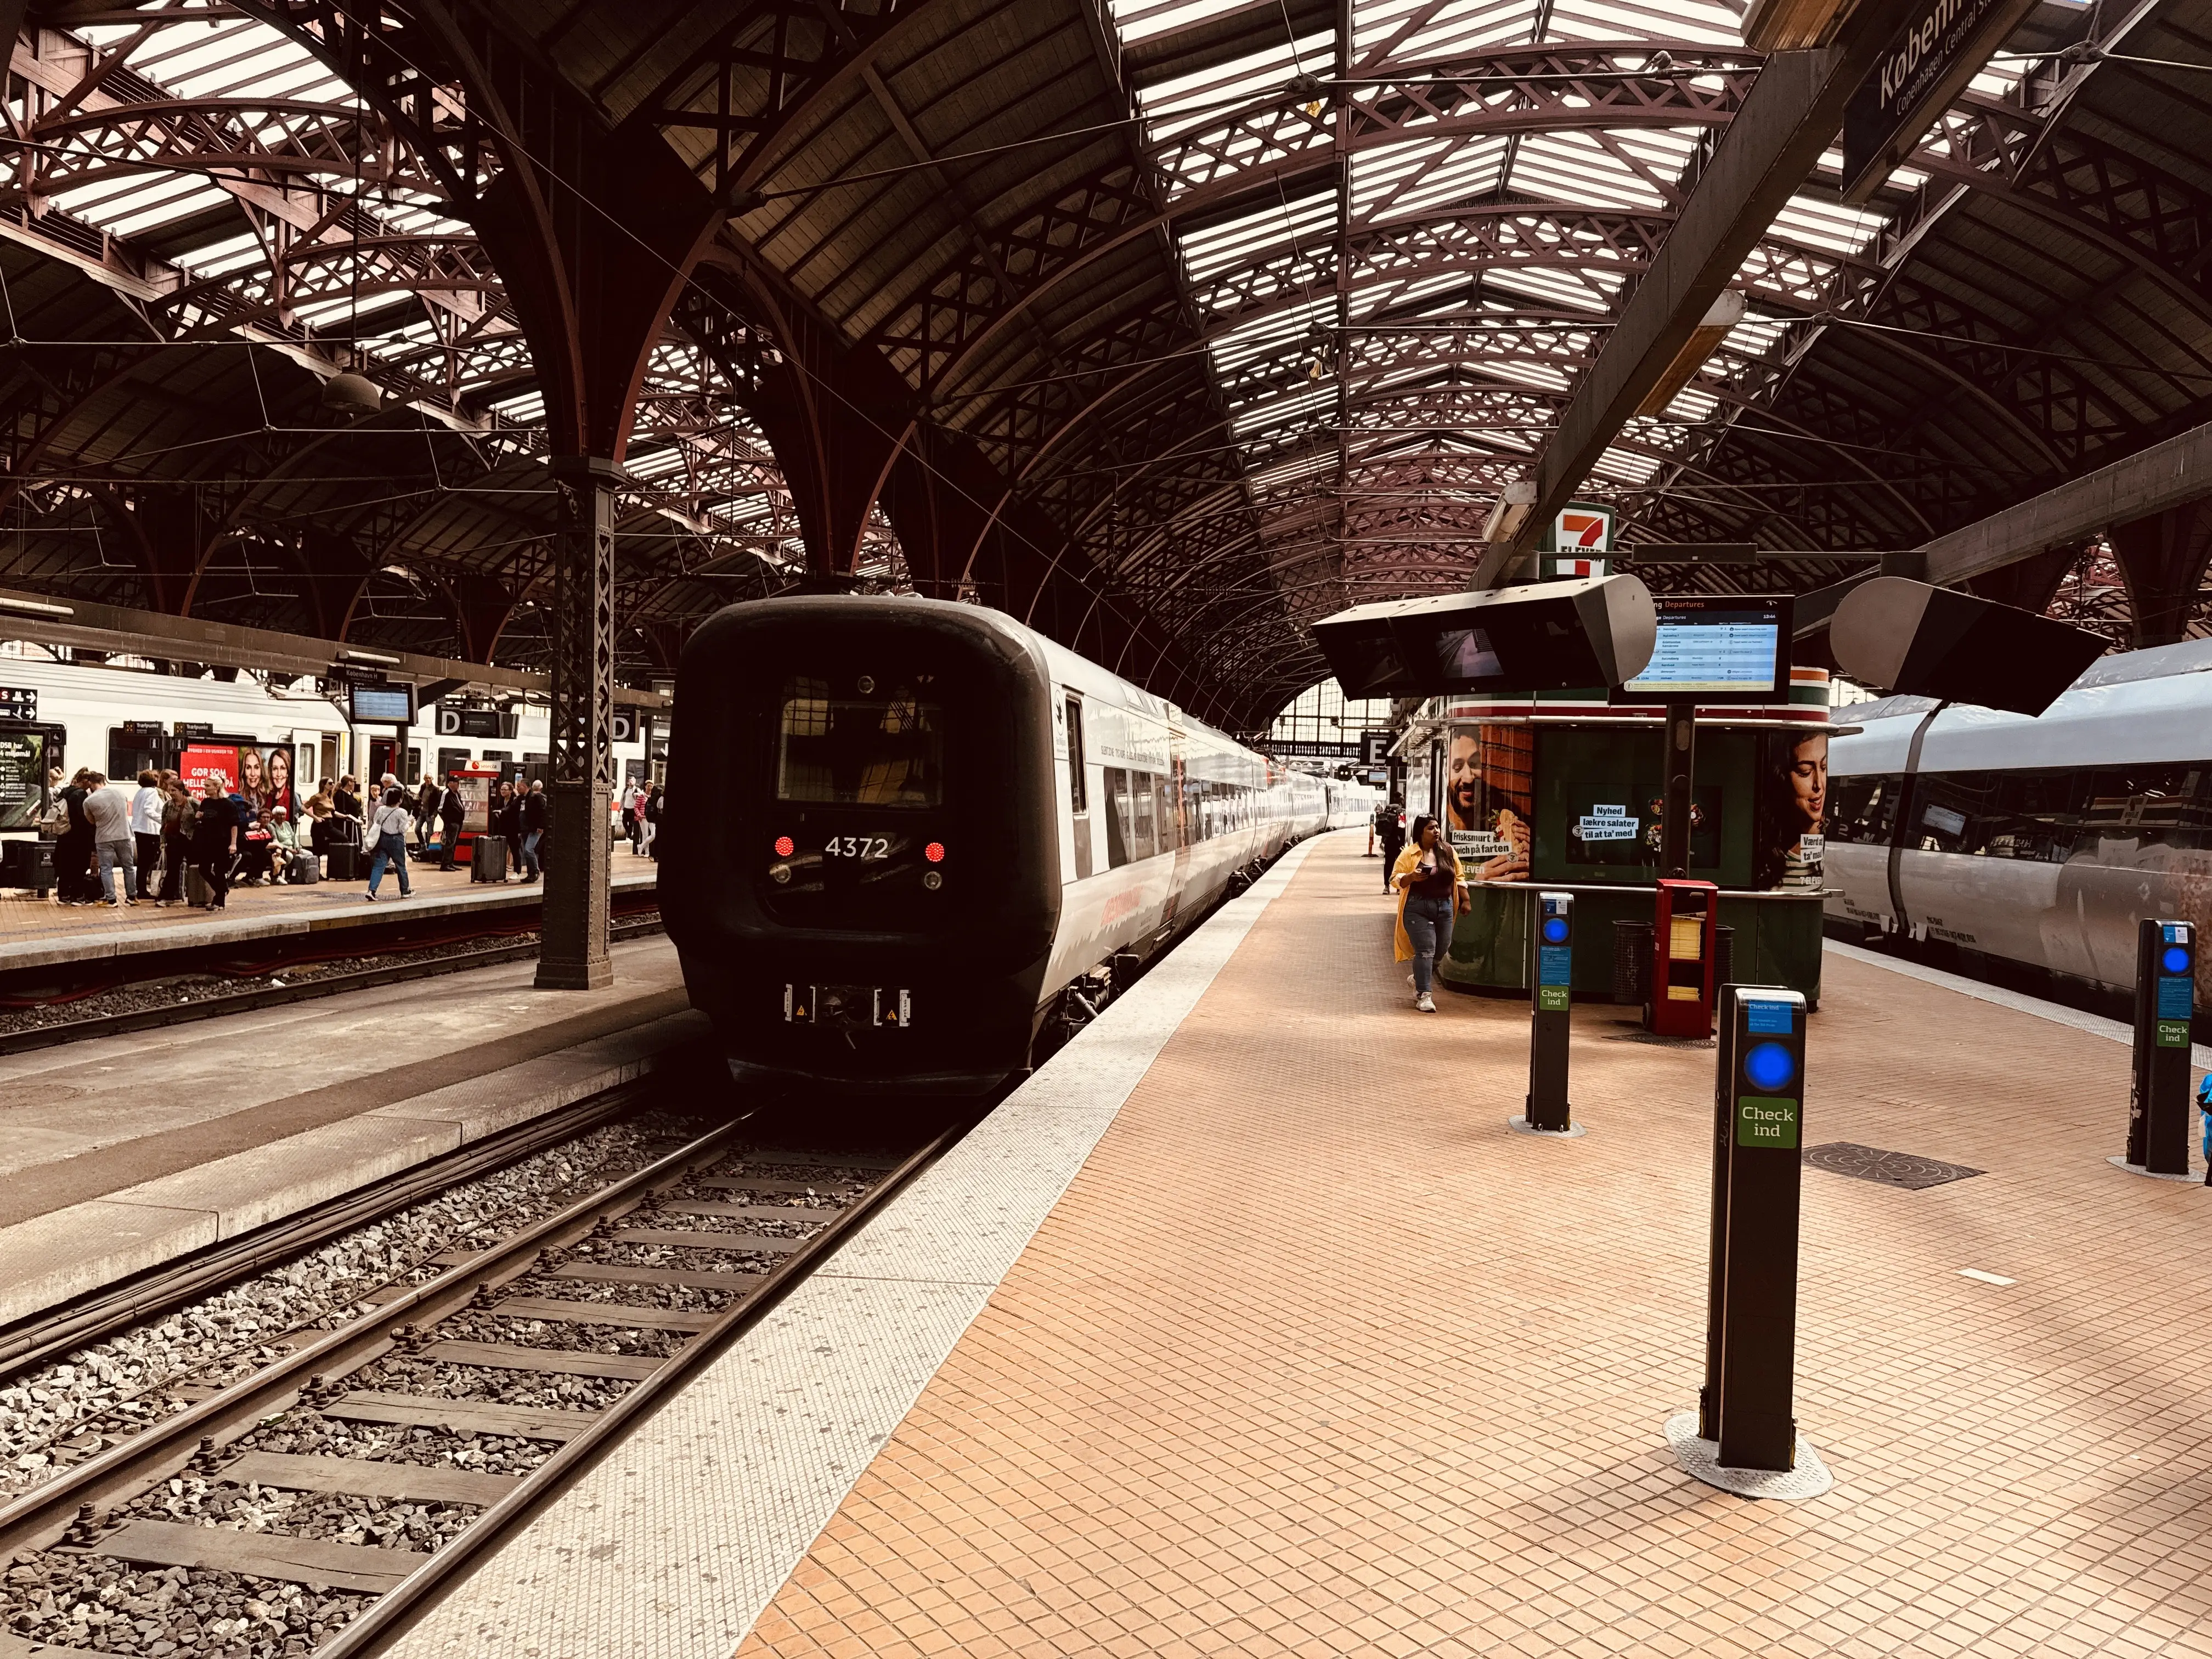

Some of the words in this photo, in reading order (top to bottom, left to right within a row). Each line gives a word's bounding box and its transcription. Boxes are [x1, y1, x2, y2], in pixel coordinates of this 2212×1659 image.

[1897, 49, 1943, 116] Copenhagen
[1945, 2, 1976, 55] Central
[1665, 601, 1705, 609] Departures
[1, 691, 8, 700] S
[441, 710, 460, 734] D
[613, 716, 630, 740] D
[1369, 739, 1387, 764] E
[429, 752, 434, 764] 2
[191, 768, 208, 777] GØR
[210, 768, 226, 777] SOM
[1596, 806, 1622, 816] Nyhed
[1583, 818, 1606, 826] lækre
[1607, 819, 1635, 827] salater
[1453, 832, 1491, 843] Frisksmurt
[1803, 837, 1818, 846] Værd
[825, 837, 888, 858] 4372
[1454, 845, 1470, 855] wich
[1471, 844, 1480, 855] på
[1481, 844, 1509, 853] farten
[1542, 990, 1567, 998] Check
[2159, 1025, 2187, 1034] Check
[2165, 1034, 2180, 1042] ind
[1742, 1106, 1794, 1122] Check
[1754, 1124, 1781, 1137] ind
